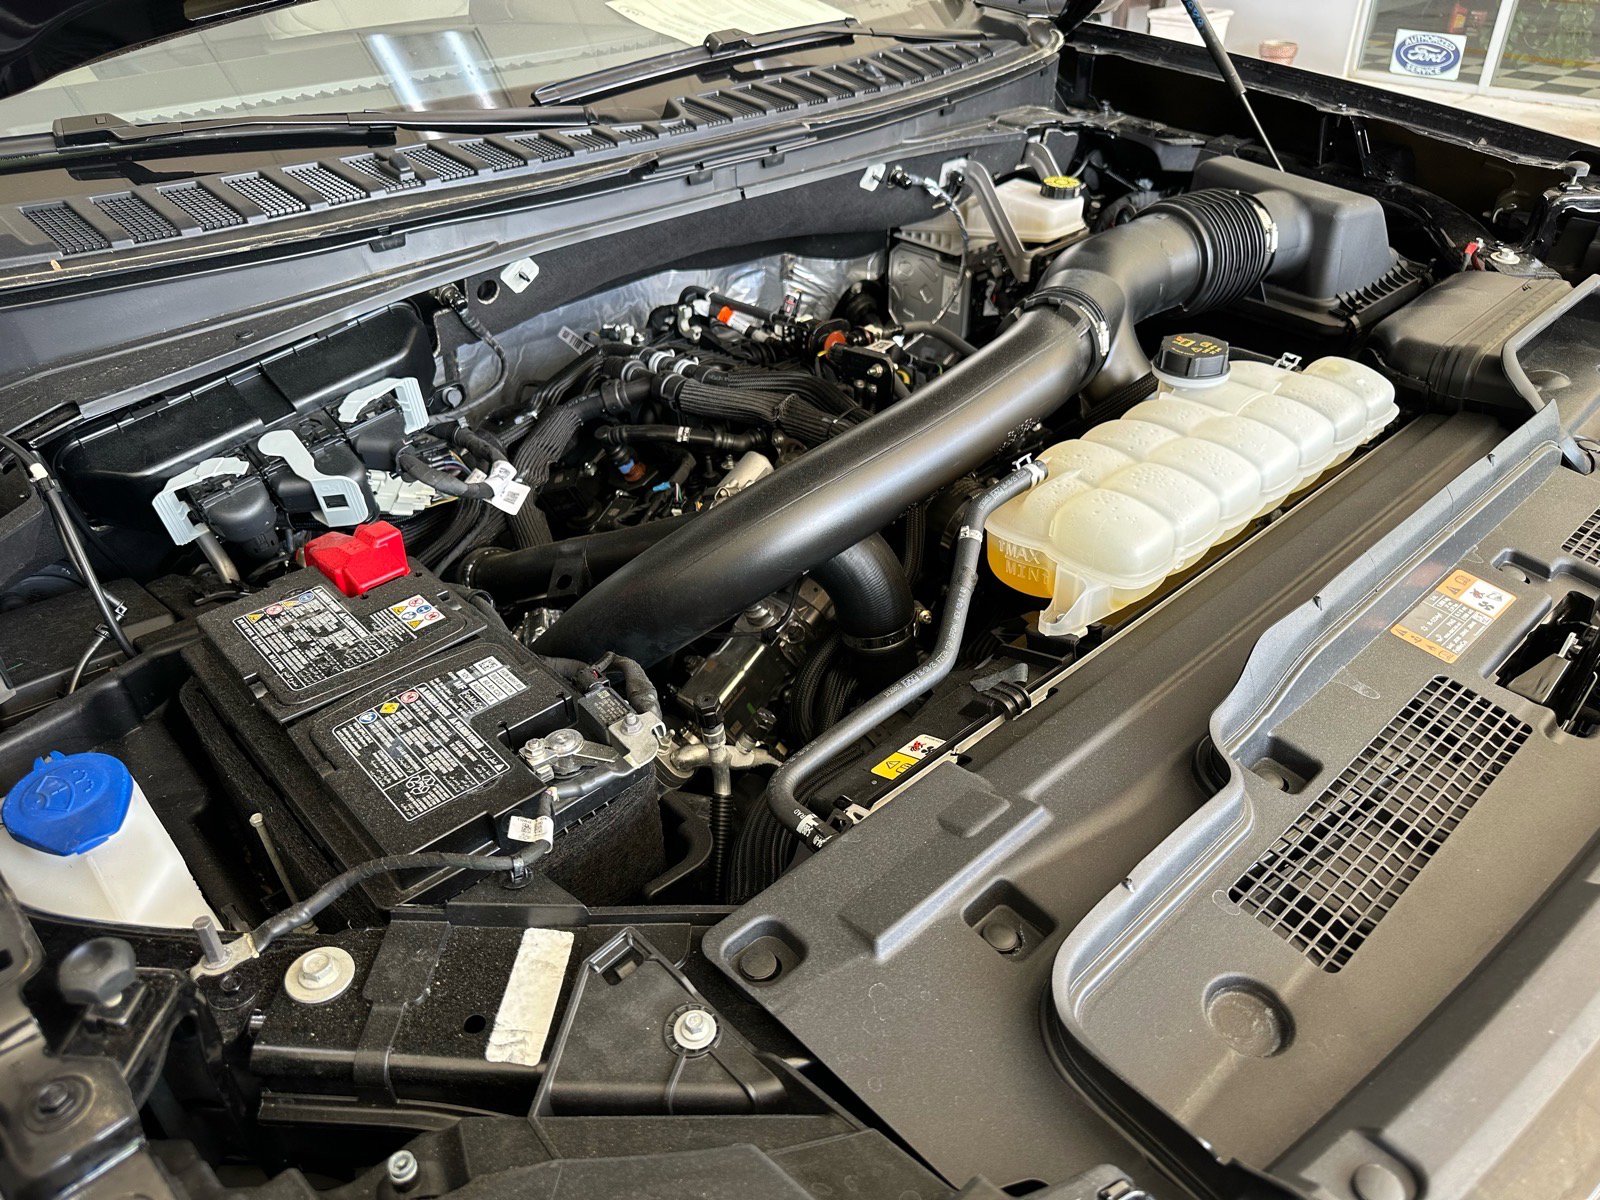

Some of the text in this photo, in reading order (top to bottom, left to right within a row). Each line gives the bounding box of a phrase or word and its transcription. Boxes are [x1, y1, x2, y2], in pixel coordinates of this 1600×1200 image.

[1407, 45, 1447, 63] Ford
[1405, 64, 1441, 76] SERVICE
[794, 808, 806, 820] RAD
